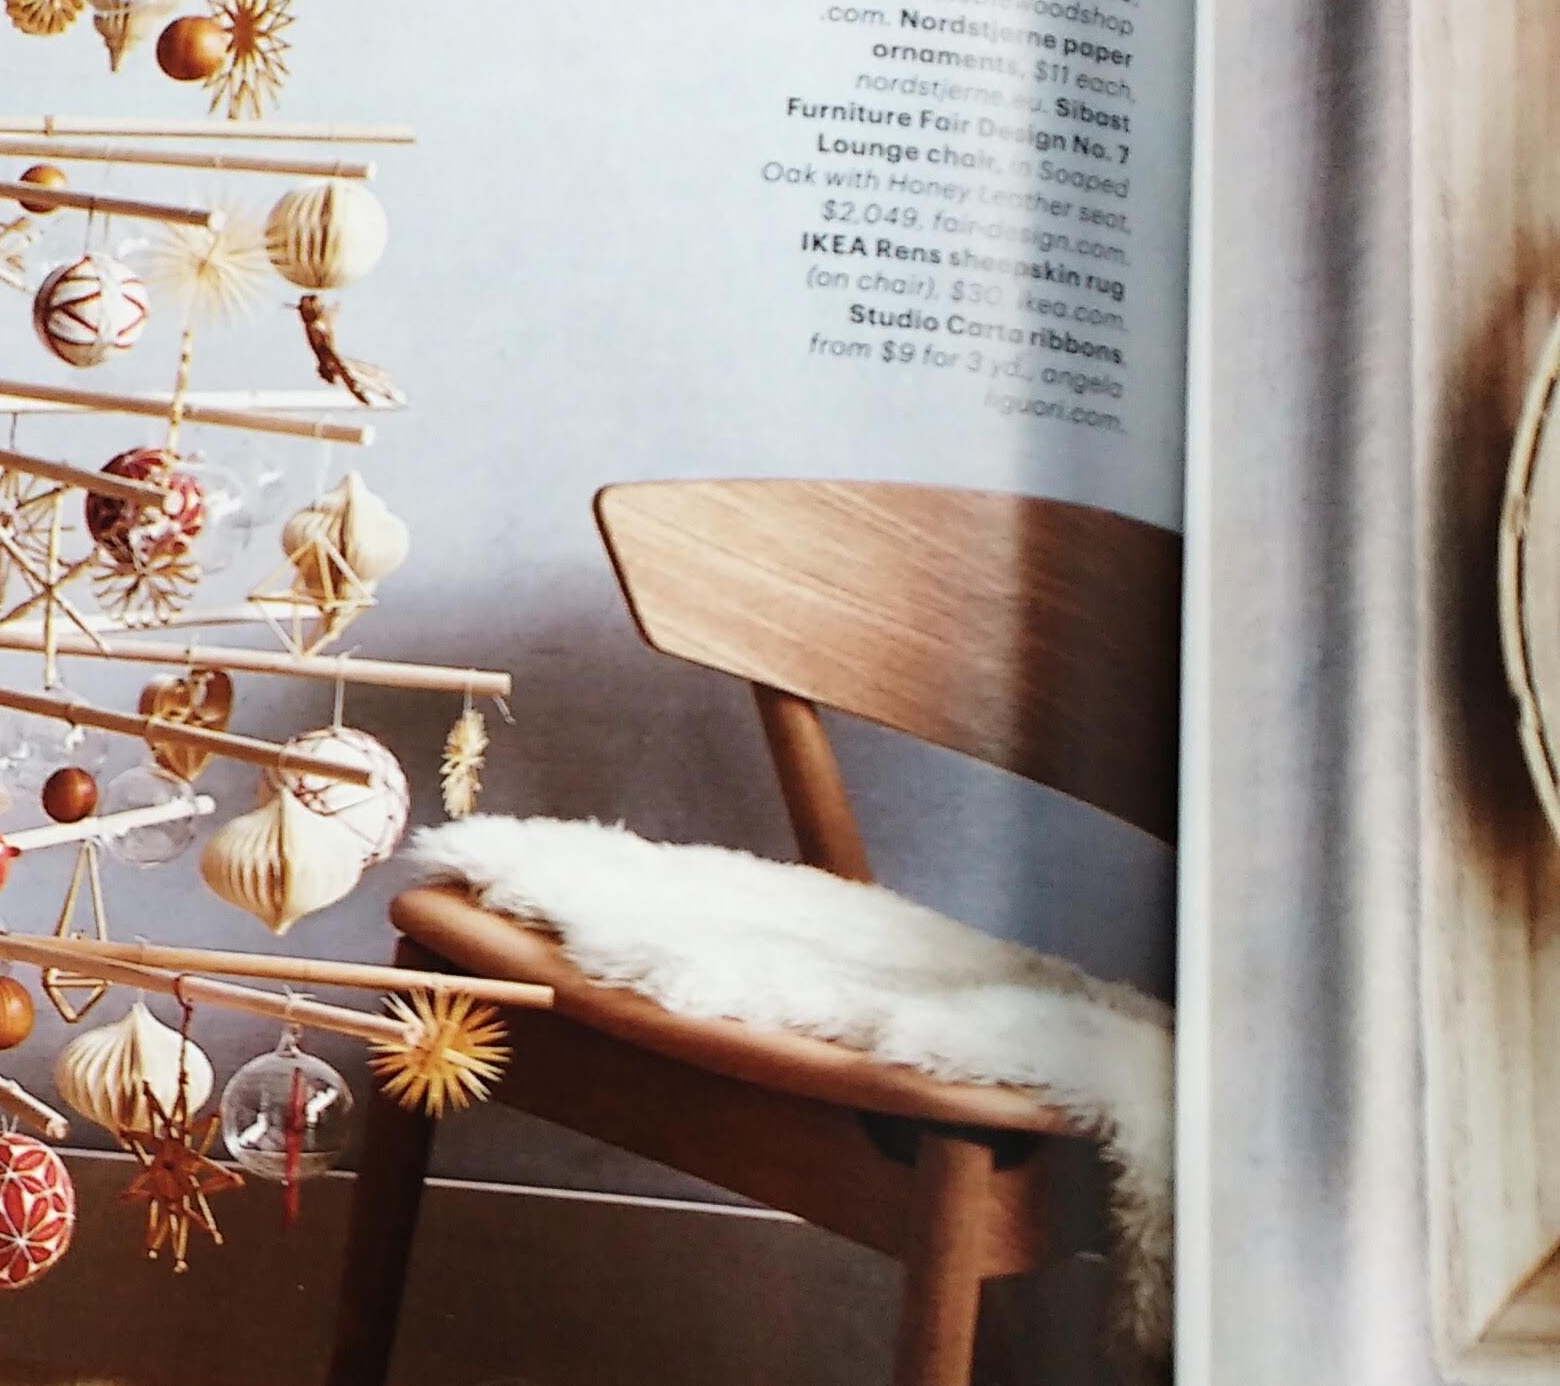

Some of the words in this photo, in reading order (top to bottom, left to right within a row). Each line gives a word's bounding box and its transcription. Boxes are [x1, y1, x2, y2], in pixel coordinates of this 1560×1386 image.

[1063, 38, 1133, 67] paper
[788, 98, 912, 128] Furniture
[817, 134, 919, 163] Lounge
[802, 232, 868, 257] IKEA
[849, 304, 940, 331] Studio
